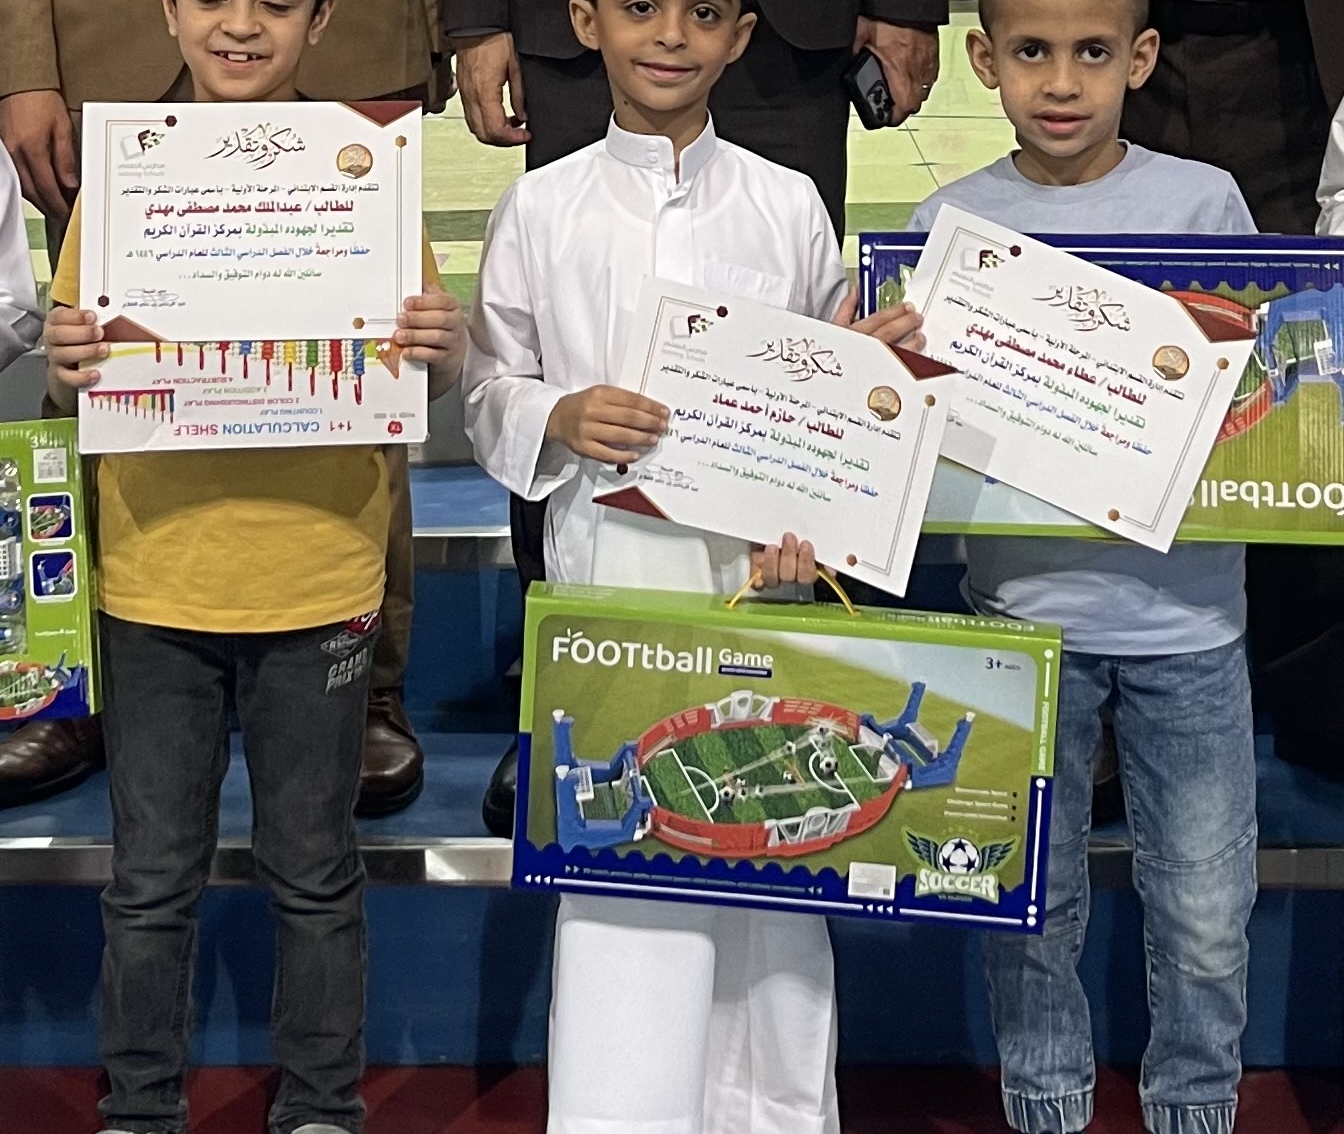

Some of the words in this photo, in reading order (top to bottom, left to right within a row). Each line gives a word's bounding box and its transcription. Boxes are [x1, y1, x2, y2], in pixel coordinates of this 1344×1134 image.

[145, 203, 174, 219] مهدي
[177, 201, 219, 217] مصطفى
[223, 203, 251, 213] محمد
[314, 200, 354, 216] للطالب
[144, 224, 176, 239] الكريم
[212, 224, 242, 239] بمركز
[966, 324, 994, 341] مهدي
[950, 341, 982, 356] الكريم
[995, 335, 1036, 357] مصطفى
[1037, 352, 1065, 371] محمد
[712, 393, 737, 408] عماد
[1107, 384, 1147, 405] للطالب
[673, 408, 706, 421] الكريم
[174, 424, 218, 436] SHELF
[222, 421, 320, 435] CALCULATION
[807, 421, 844, 440] للطالب
[552, 629, 712, 674] FOOTtball
[718, 648, 774, 667] Game
[918, 868, 996, 899] SOCCER
